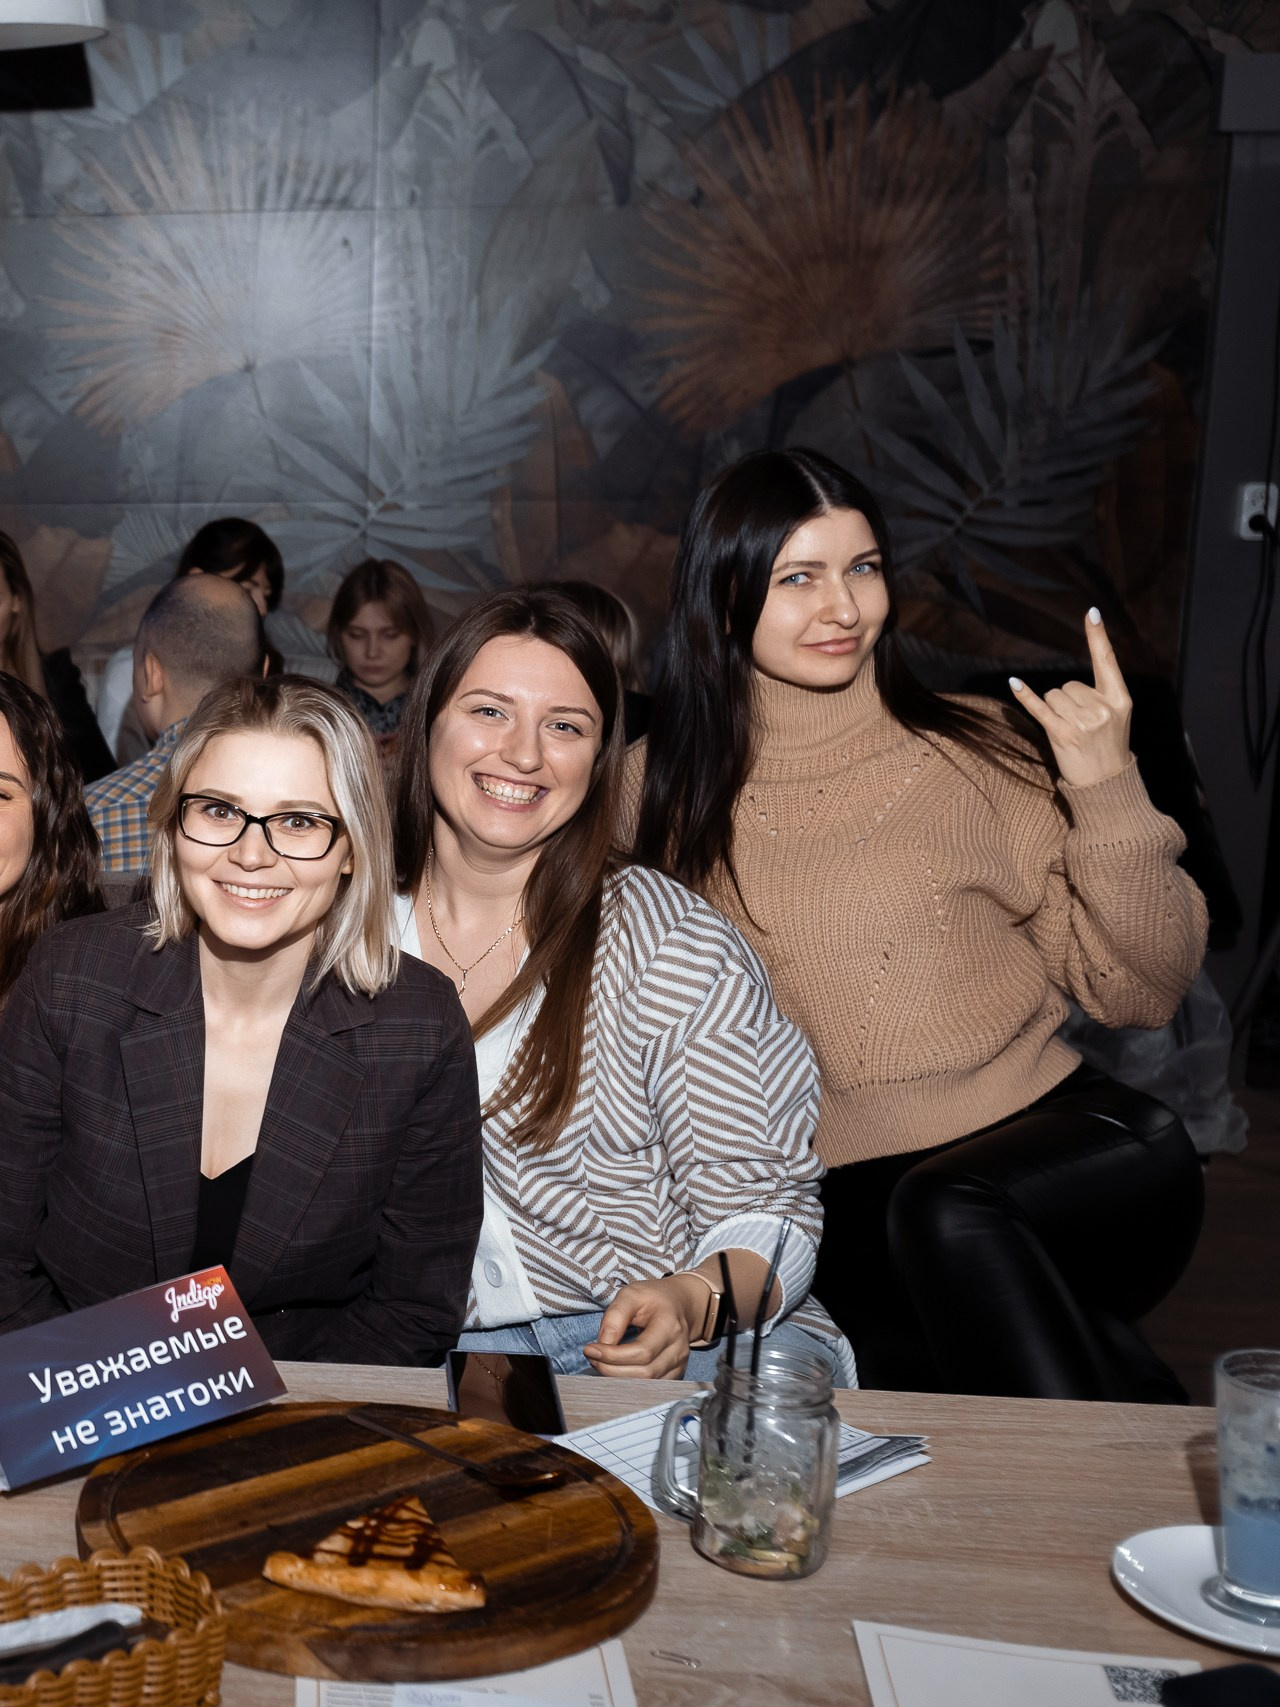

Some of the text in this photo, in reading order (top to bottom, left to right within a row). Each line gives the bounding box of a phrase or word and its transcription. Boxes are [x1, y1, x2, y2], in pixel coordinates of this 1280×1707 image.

[165, 1278, 225, 1323] Indigo
[28, 1315, 248, 1405] Уважаемые
[51, 1366, 255, 1455] не знатоки
